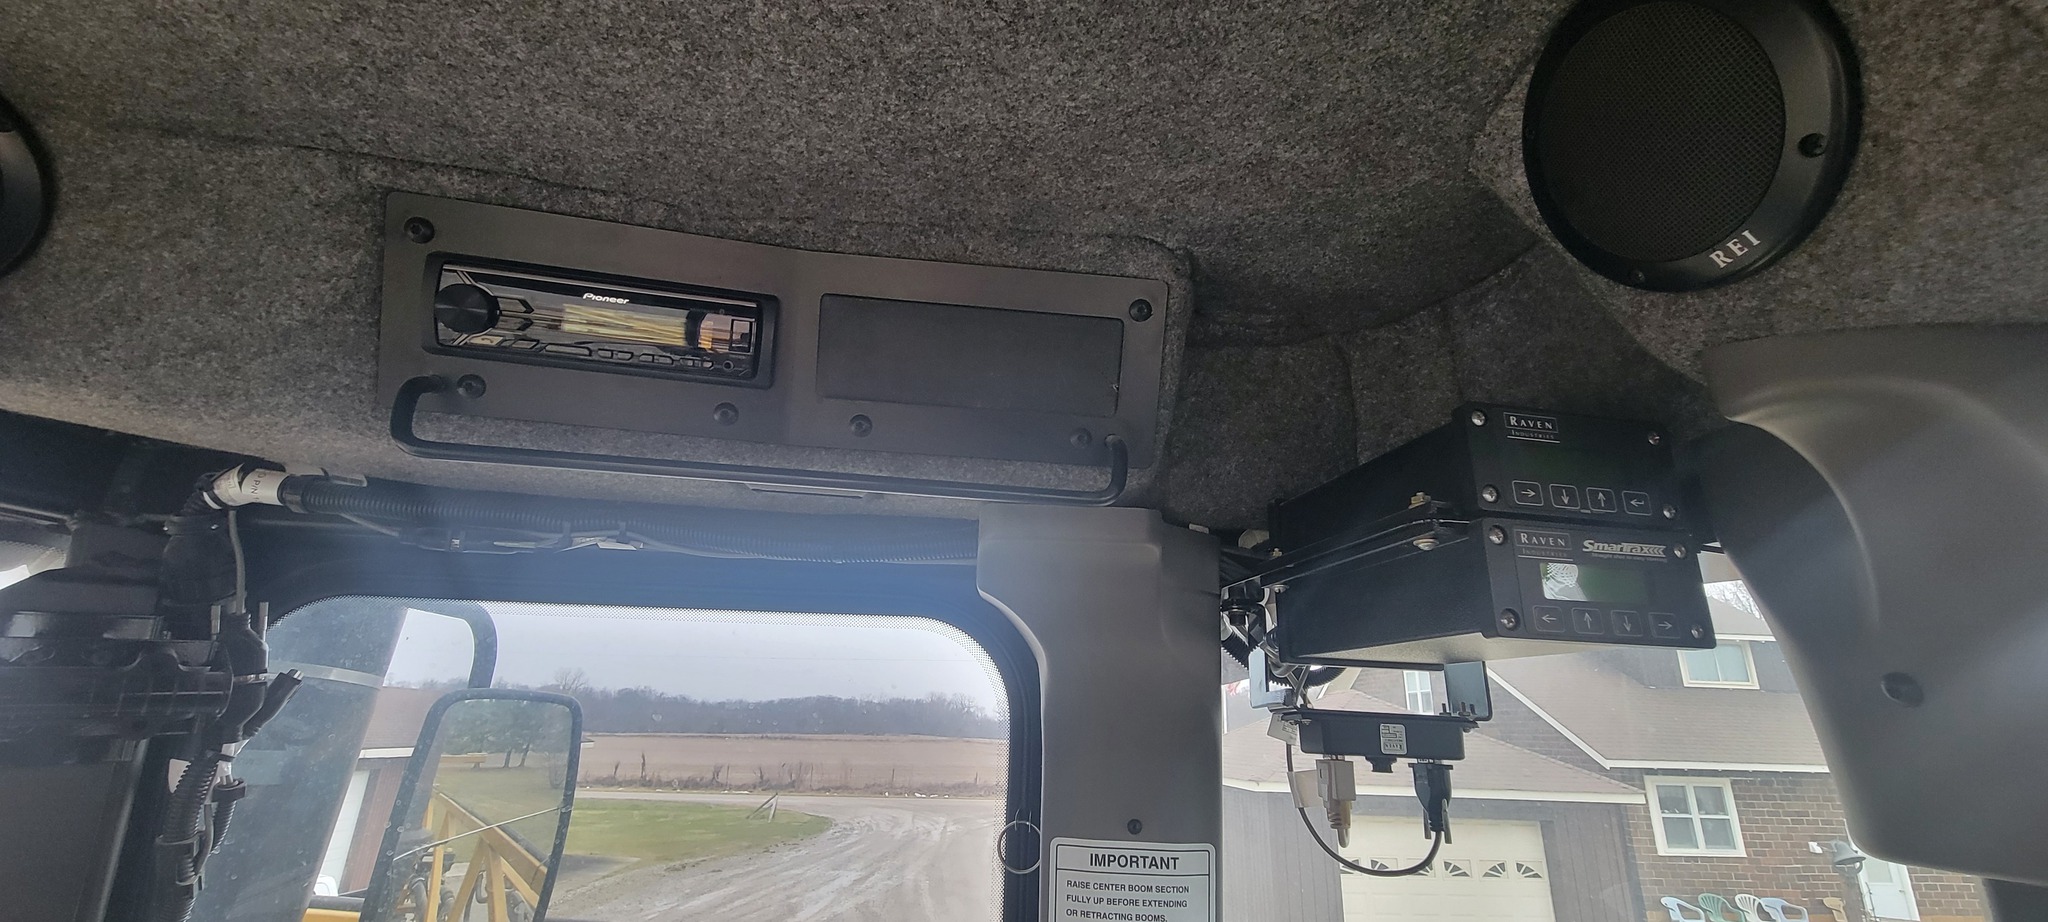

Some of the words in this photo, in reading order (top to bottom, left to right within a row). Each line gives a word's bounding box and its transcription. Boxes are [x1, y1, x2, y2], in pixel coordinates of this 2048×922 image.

[1709, 230, 1761, 269] REI
[582, 292, 630, 304] Pioneer
[1509, 415, 1553, 430] RAVEN
[1520, 532, 1566, 547] RAVEN
[1090, 853, 1180, 870] IMPORTANT
[1066, 880, 1091, 890] RAISE
[1092, 882, 1126, 892] CENTER
[1128, 884, 1153, 893] BOOM
[1155, 885, 1190, 894] SECTION
[1066, 894, 1092, 904] FULLY
[1093, 897, 1105, 905] UP
[1106, 897, 1140, 907] BEFORE
[1142, 899, 1188, 908] EXTENDING
[1065, 908, 1078, 917] OR
[1080, 910, 1133, 921] RETRACTING
